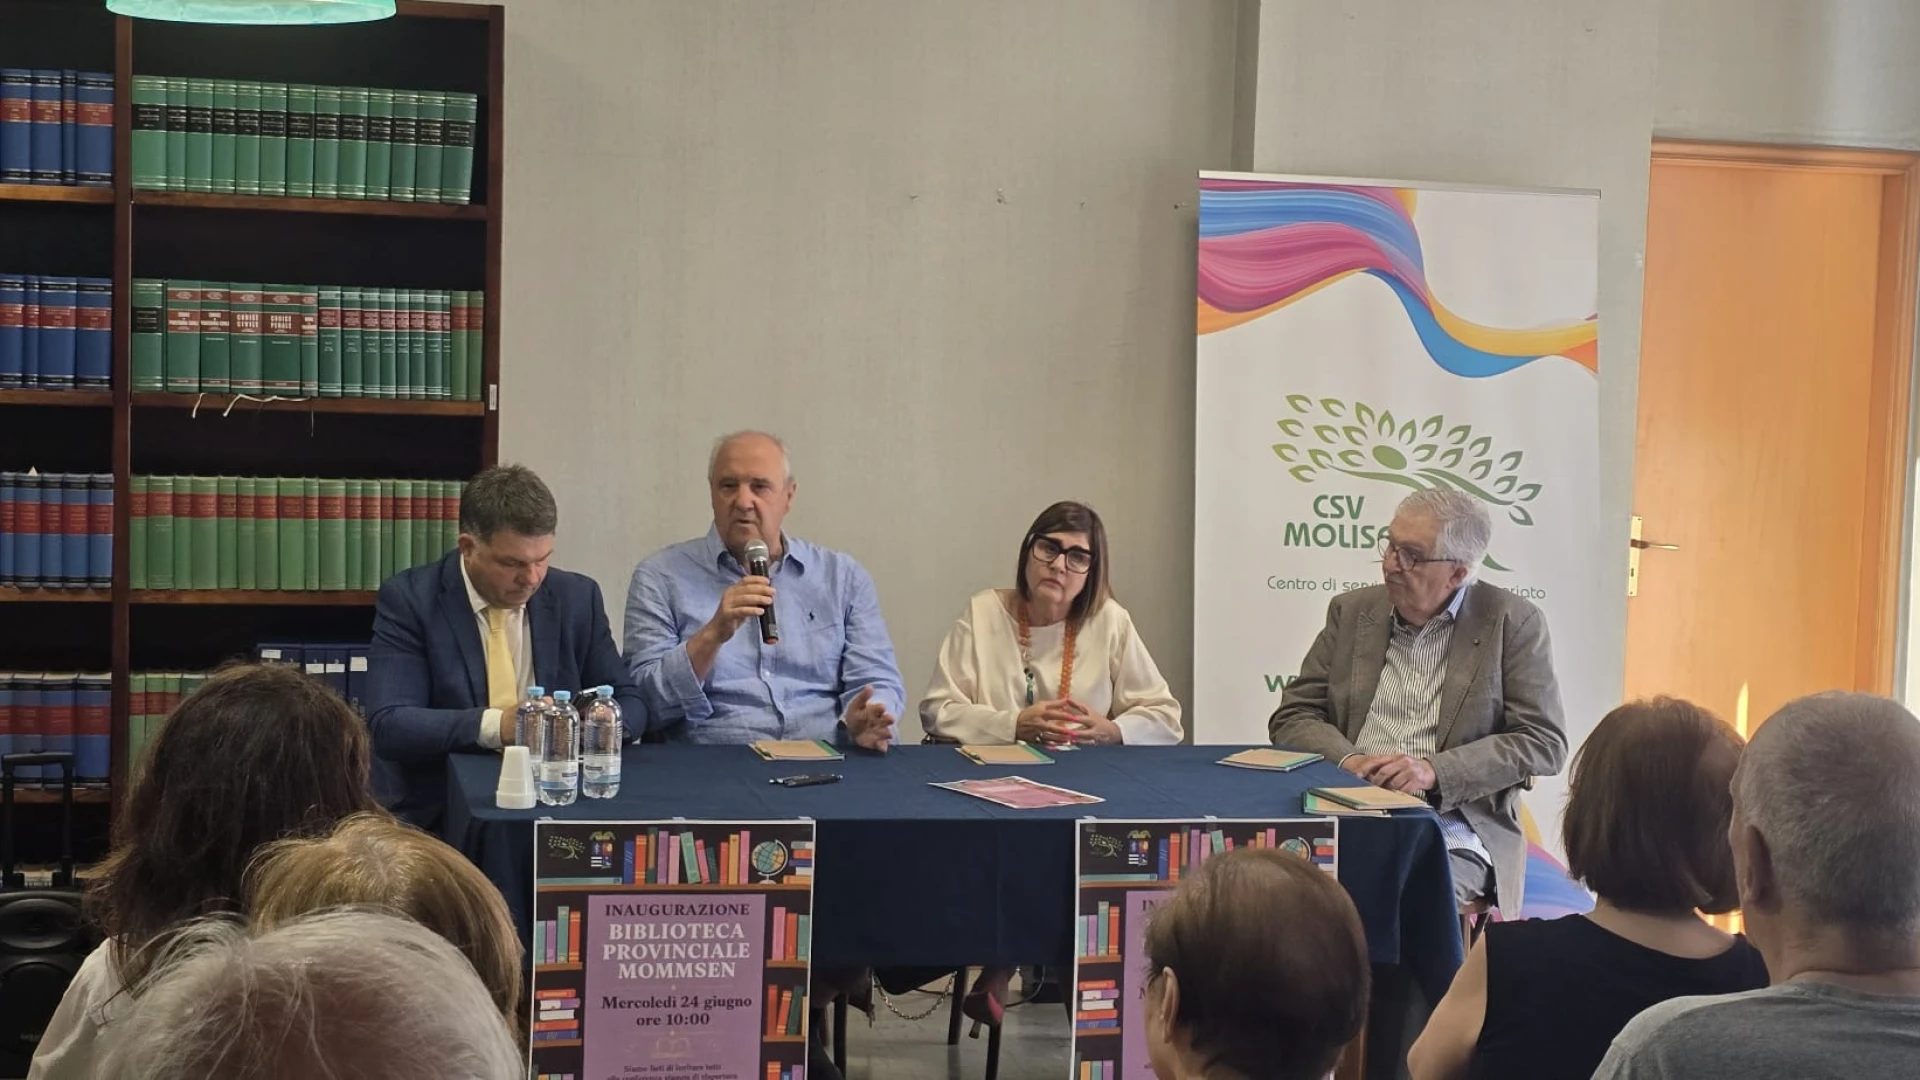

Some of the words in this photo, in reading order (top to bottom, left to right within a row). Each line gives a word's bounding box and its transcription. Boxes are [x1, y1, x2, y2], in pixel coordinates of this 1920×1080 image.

[1313, 494, 1365, 520] CSV
[1267, 575, 1317, 591] Centro
[1322, 577, 1337, 591] di
[605, 904, 750, 917] INAUGURAZIONE
[609, 922, 745, 940] BIBLIOTECA
[603, 942, 750, 961] PROVINCIALE
[618, 961, 736, 980] MOMMSEN
[681, 995, 699, 1008] 24
[703, 995, 752, 1011] giugno
[636, 1016, 662, 1027] ore
[667, 1012, 710, 1026] 10:00
